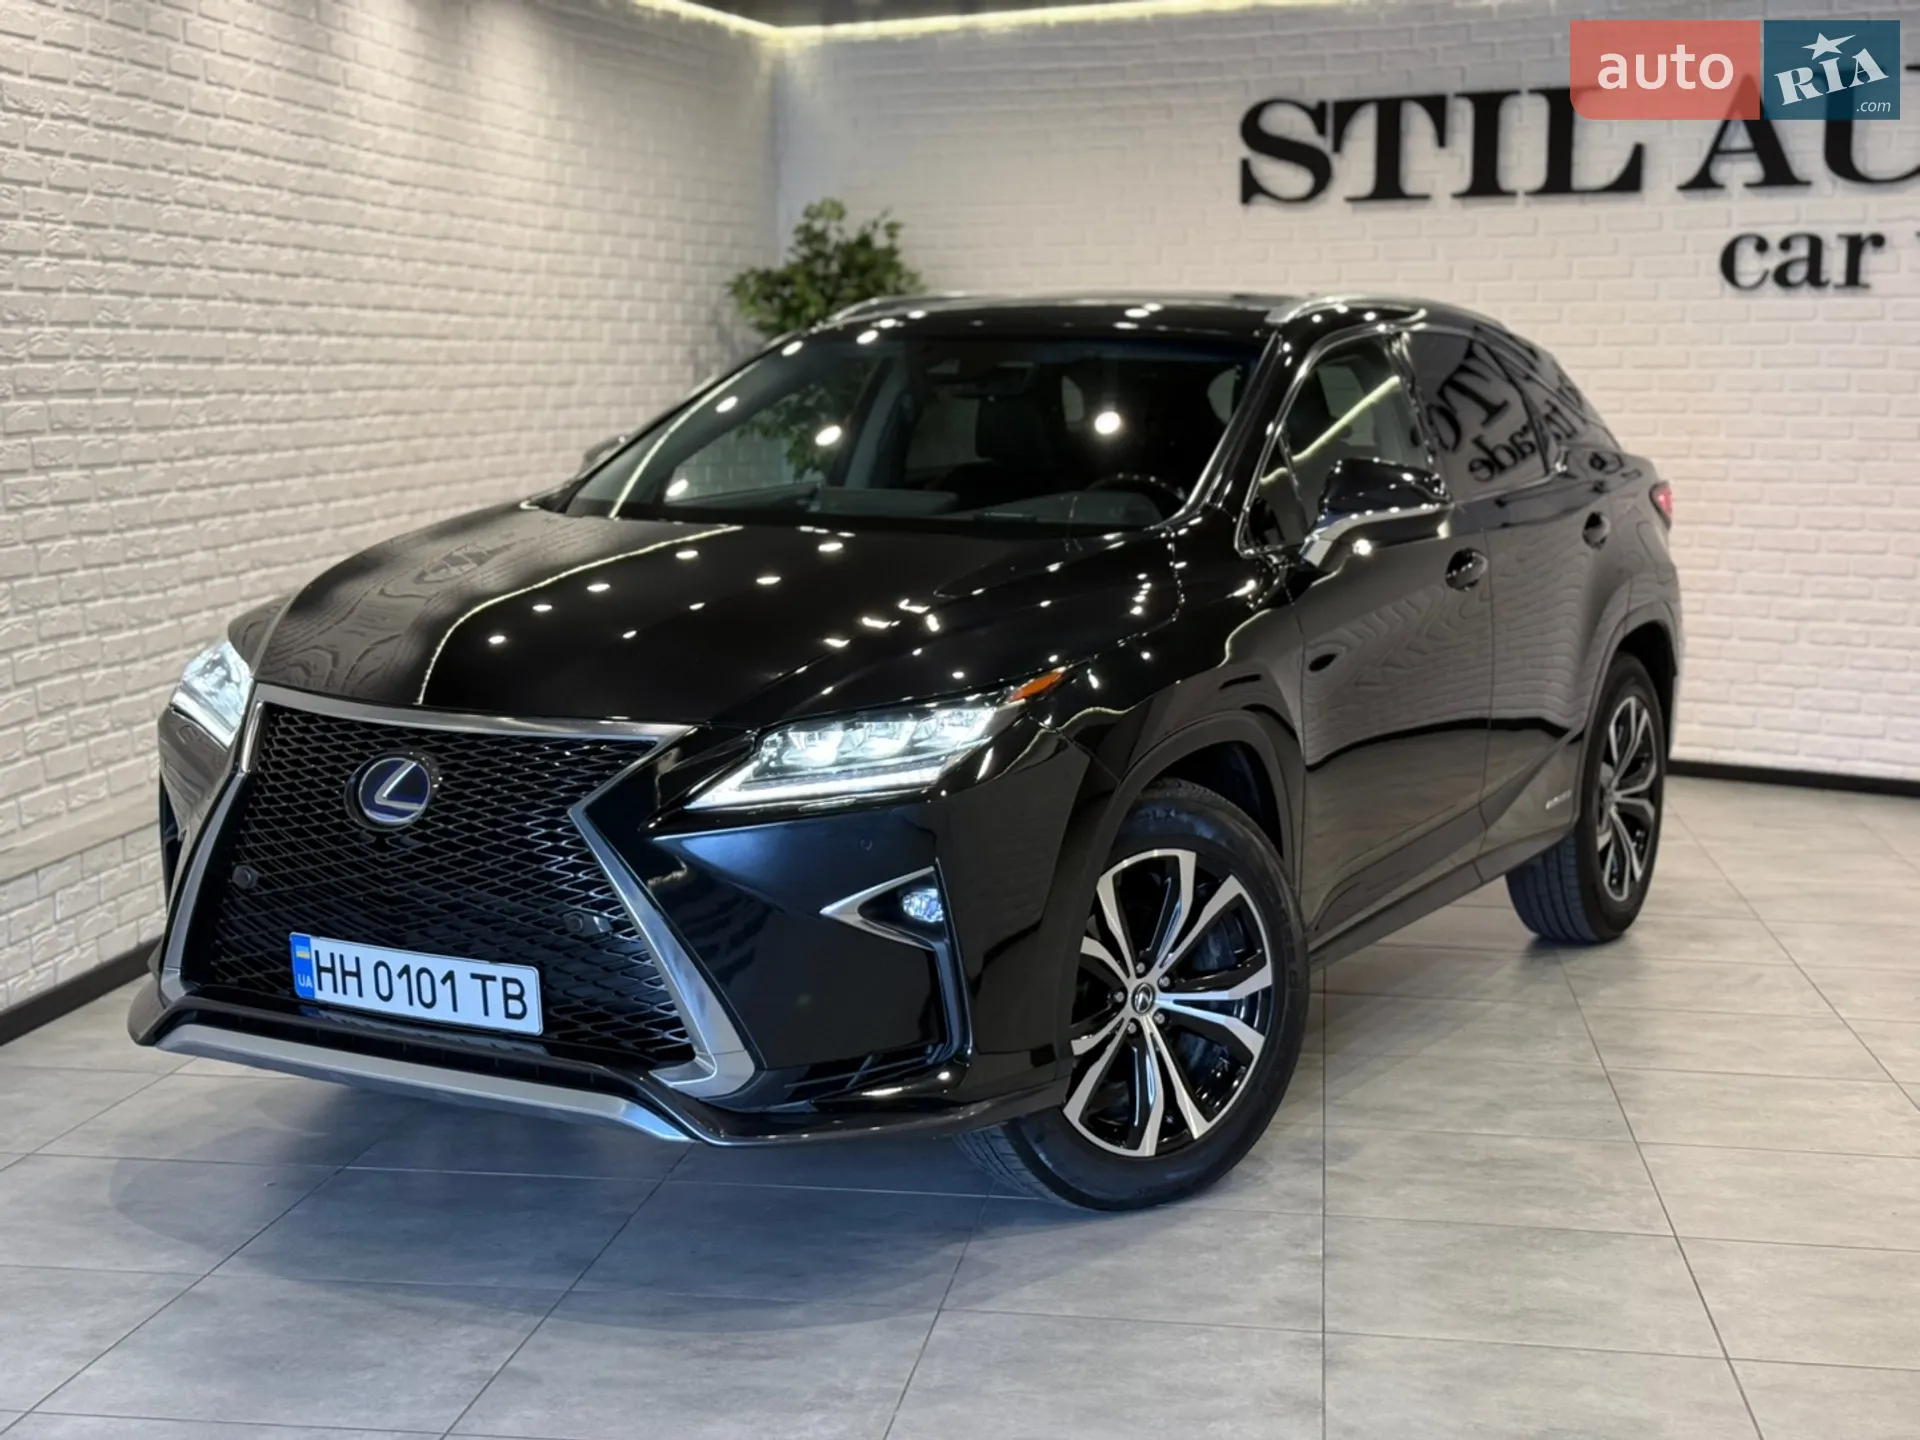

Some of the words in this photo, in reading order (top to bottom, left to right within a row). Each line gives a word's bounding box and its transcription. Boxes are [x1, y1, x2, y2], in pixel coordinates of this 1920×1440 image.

[1240, 88, 1646, 206] STIL
[1720, 231, 1886, 291] car
[297, 973, 314, 989] UA
[314, 950, 363, 998] HH
[373, 960, 459, 1013] 0101
[470, 972, 528, 1021] TB
